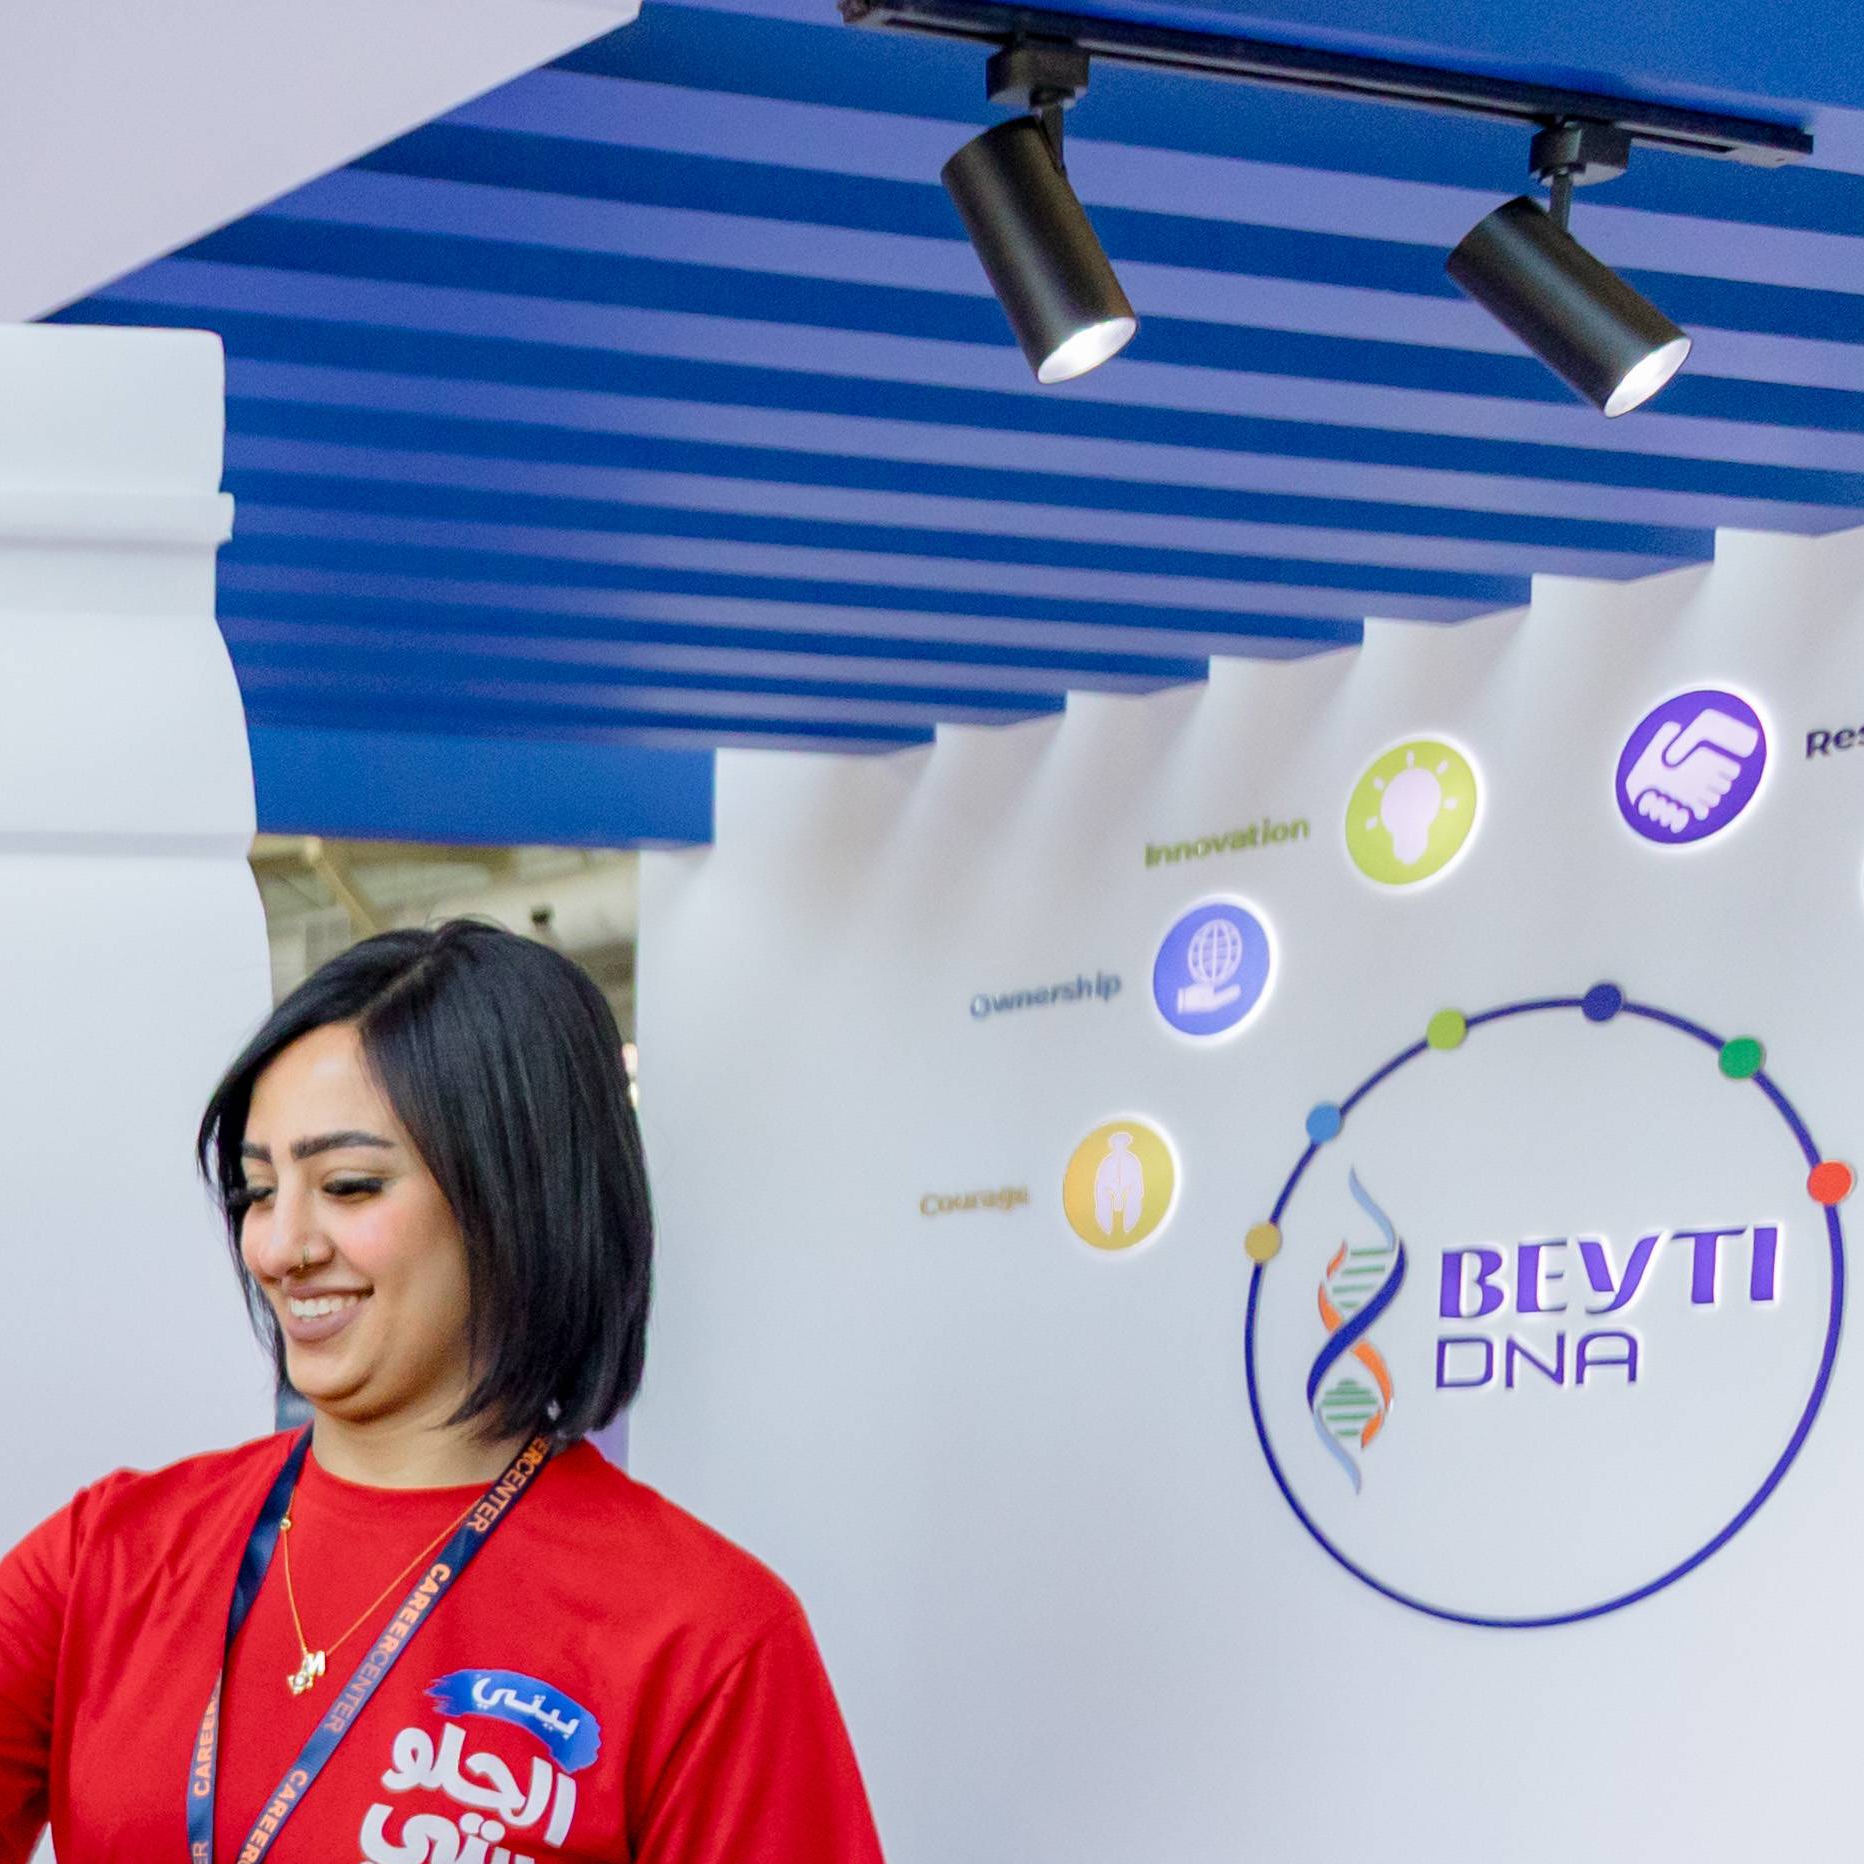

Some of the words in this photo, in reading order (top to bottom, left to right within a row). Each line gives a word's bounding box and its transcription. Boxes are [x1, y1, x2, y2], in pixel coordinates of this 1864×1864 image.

[1144, 817, 1311, 868] Innovation
[969, 968, 1123, 1020] Ownership
[1439, 1224, 1781, 1320] BEYTI
[1434, 1329, 1639, 1389] DNA
[471, 1676, 580, 1741] بيتي
[381, 1723, 577, 1848] الحلو
